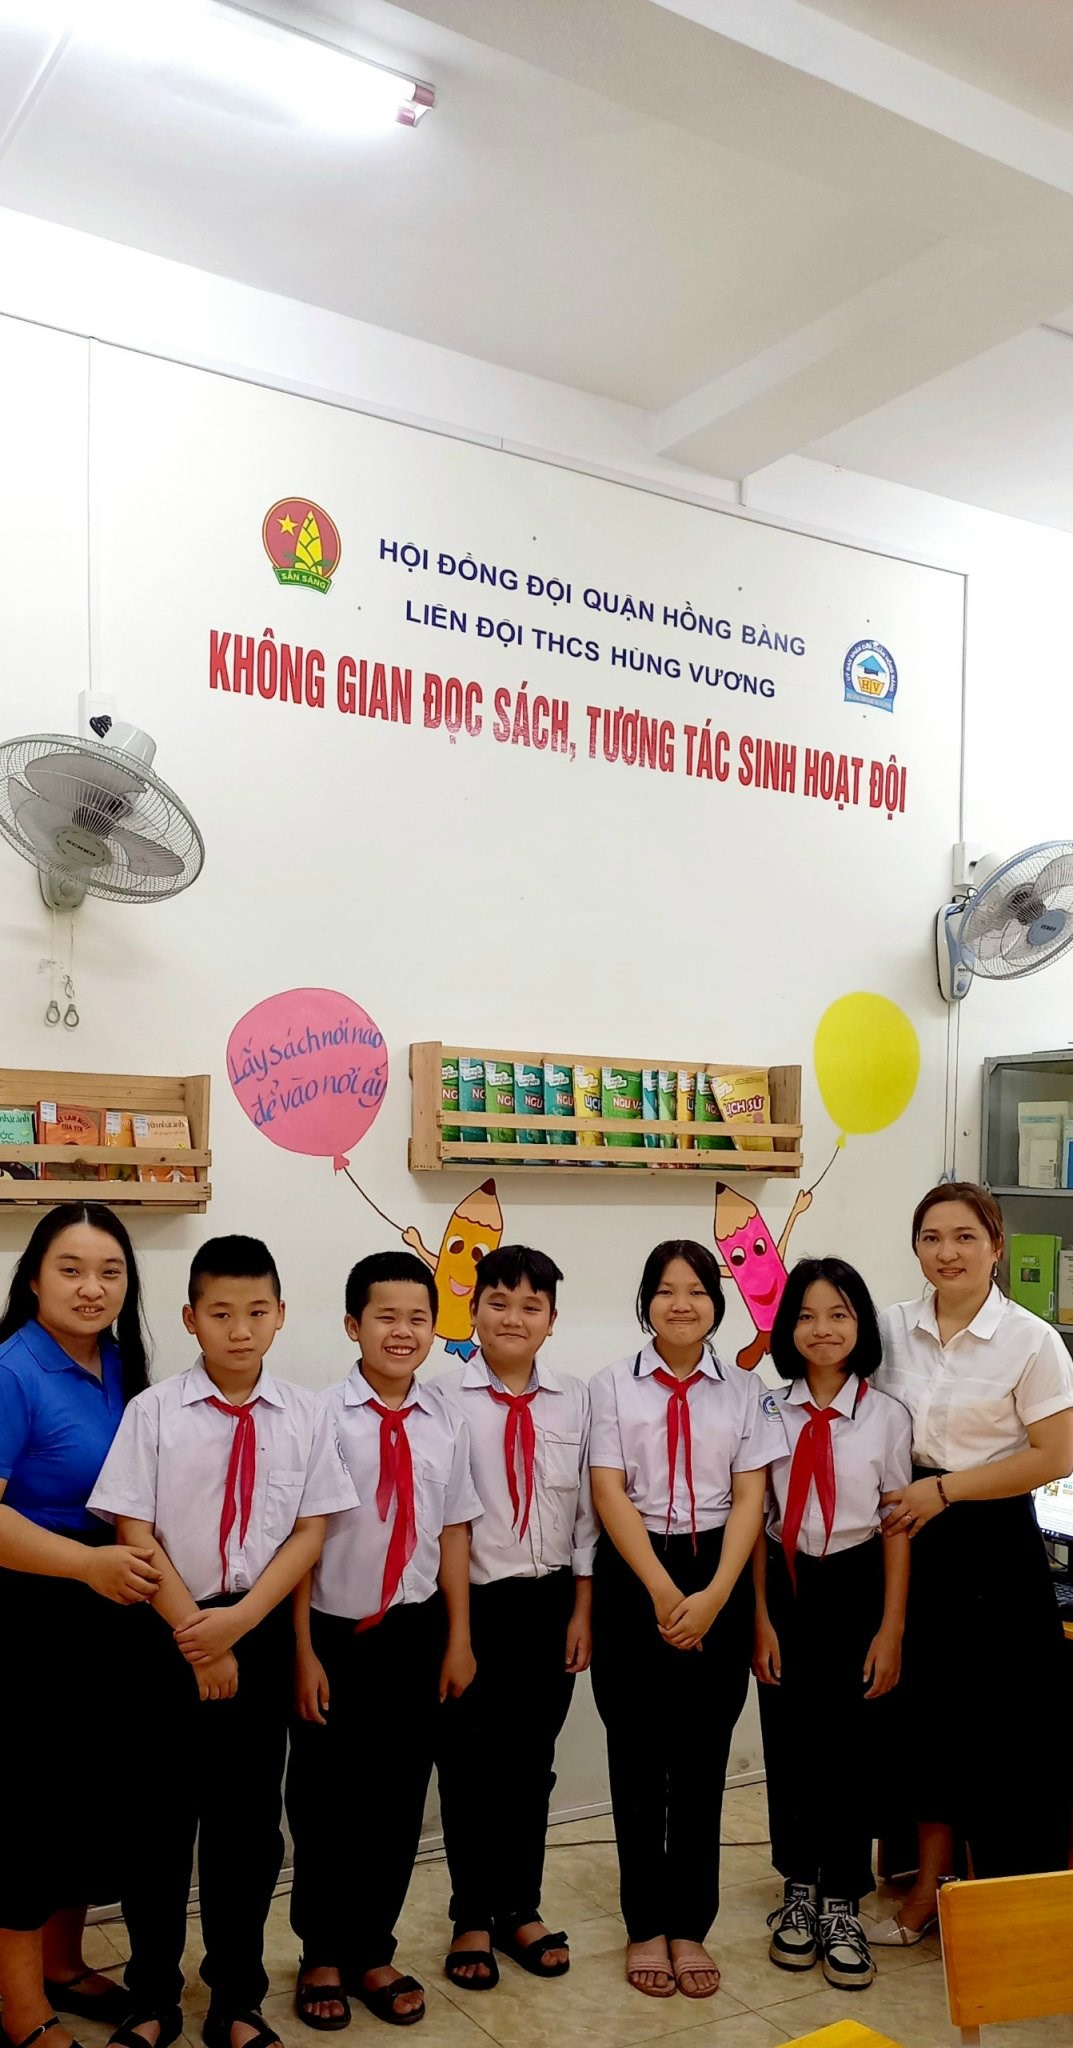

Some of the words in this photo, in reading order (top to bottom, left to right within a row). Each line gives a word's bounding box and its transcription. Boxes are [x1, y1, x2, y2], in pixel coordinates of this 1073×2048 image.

[379, 538, 429, 573] HỘI
[436, 552, 518, 591] ĐỒNG
[525, 574, 572, 607] ĐỘI
[583, 588, 655, 622] QUẬN
[662, 600, 732, 640] HỒNG
[741, 623, 806, 657] BÀNG
[405, 600, 467, 633] LIÊN
[475, 616, 523, 648] ĐỘI
[531, 628, 600, 662] THCS
[611, 645, 681, 679] HÙNG
[688, 662, 776, 698] VƯƠNG
[208, 627, 326, 709] KHÔNG
[336, 655, 413, 726] GIAN
[422, 672, 484, 746] ĐỌC
[492, 680, 577, 762] SÁCH,
[586, 704, 676, 774] TƯƠNG
[683, 717, 731, 783] TÁC
[737, 735, 797, 794] SINH
[803, 747, 865, 811] HOẠT
[868, 754, 908, 821] ĐỘI
